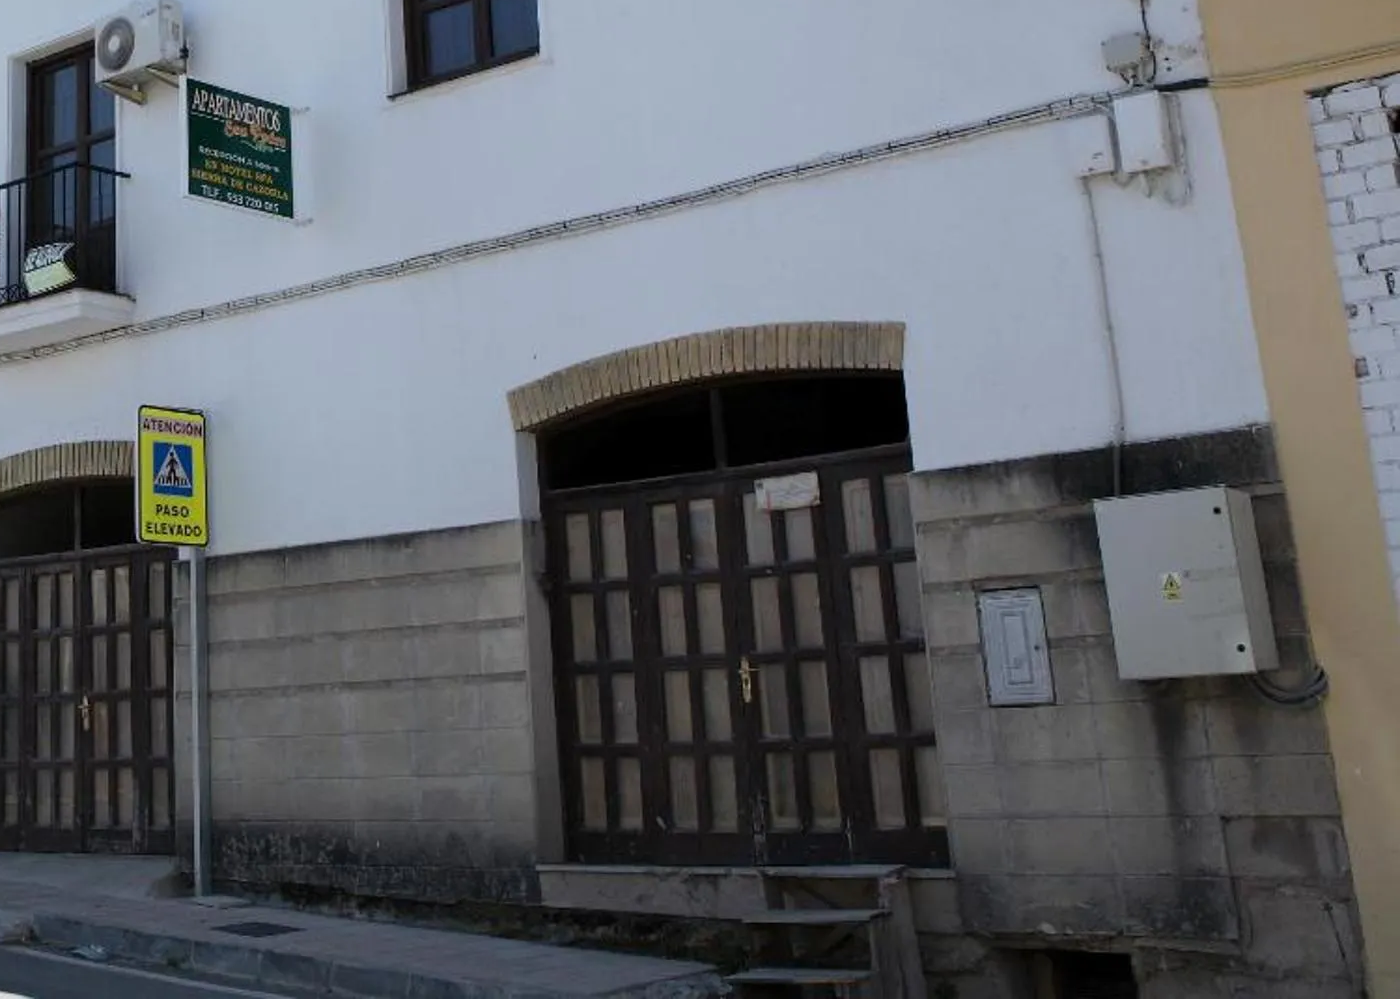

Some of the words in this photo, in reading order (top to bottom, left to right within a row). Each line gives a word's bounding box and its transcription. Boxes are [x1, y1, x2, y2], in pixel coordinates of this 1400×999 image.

[192, 87, 281, 132] APARTAMENTOS
[220, 163, 253, 178] HOTEL
[155, 503, 189, 518] PASO
[146, 521, 202, 538] ELEVADO
